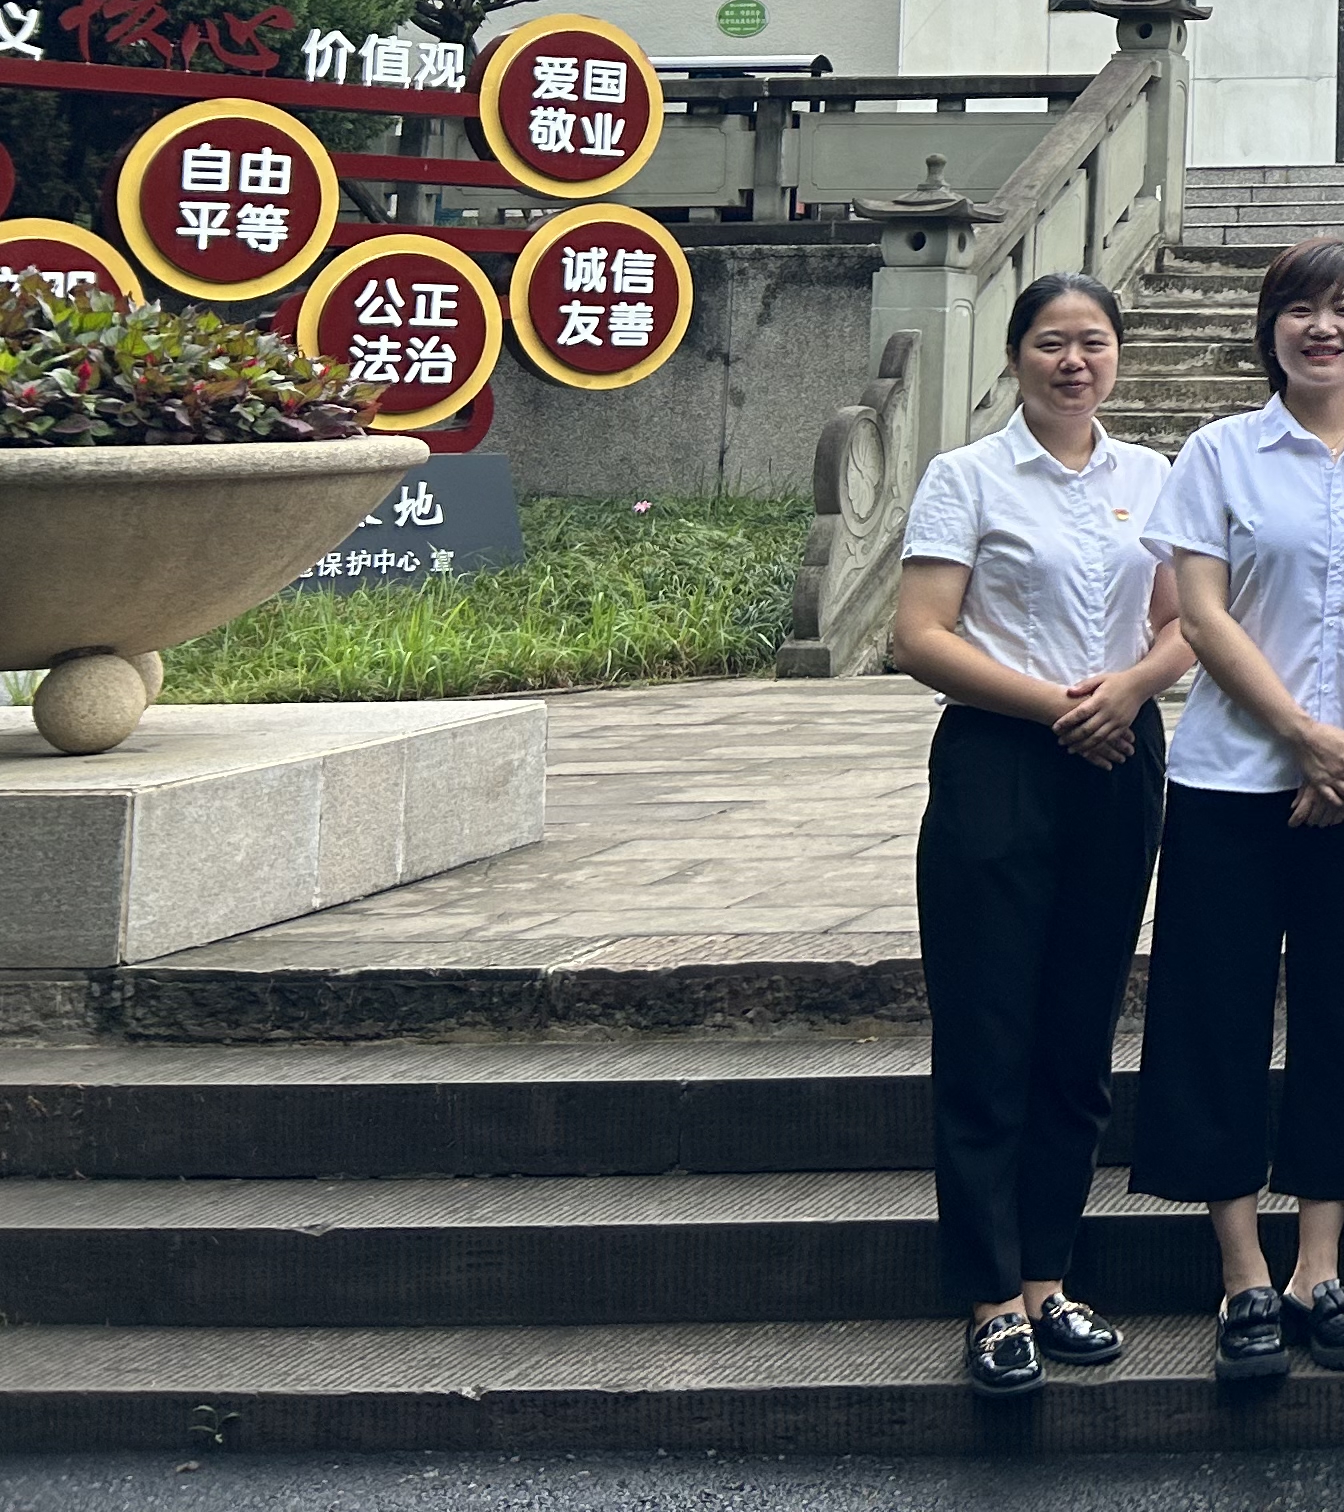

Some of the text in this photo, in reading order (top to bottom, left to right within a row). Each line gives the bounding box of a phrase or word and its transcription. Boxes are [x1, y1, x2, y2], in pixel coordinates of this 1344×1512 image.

[532, 56, 628, 105] 爱国
[529, 106, 626, 158] 敬业
[182, 142, 292, 196] 自由
[175, 201, 290, 254] 平等
[561, 246, 658, 296] 诚信
[354, 277, 460, 329] 公正
[557, 299, 655, 349] 友善
[350, 334, 458, 385] 法治
